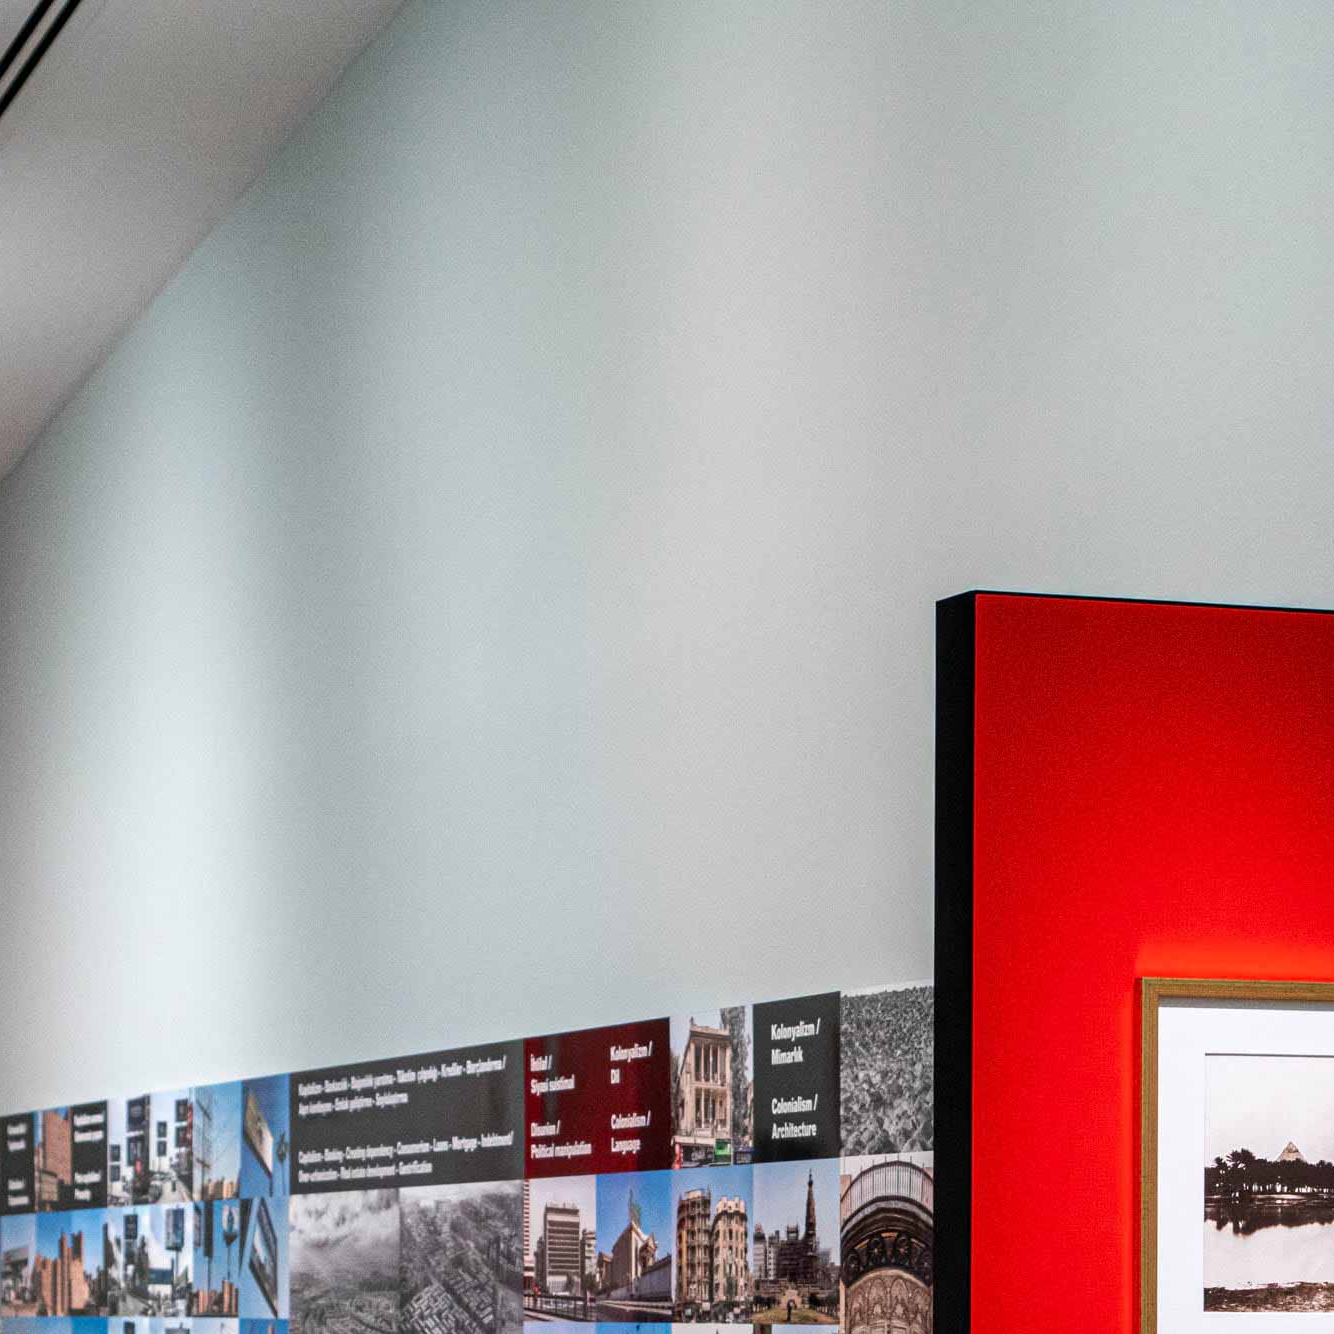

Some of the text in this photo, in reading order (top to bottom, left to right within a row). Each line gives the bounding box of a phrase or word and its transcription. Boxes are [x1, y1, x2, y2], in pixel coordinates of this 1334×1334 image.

[770, 1020, 815, 1043] Kolonyalizm
[771, 1095, 812, 1115] Colonialism
[771, 1121, 817, 1140] Architecture
